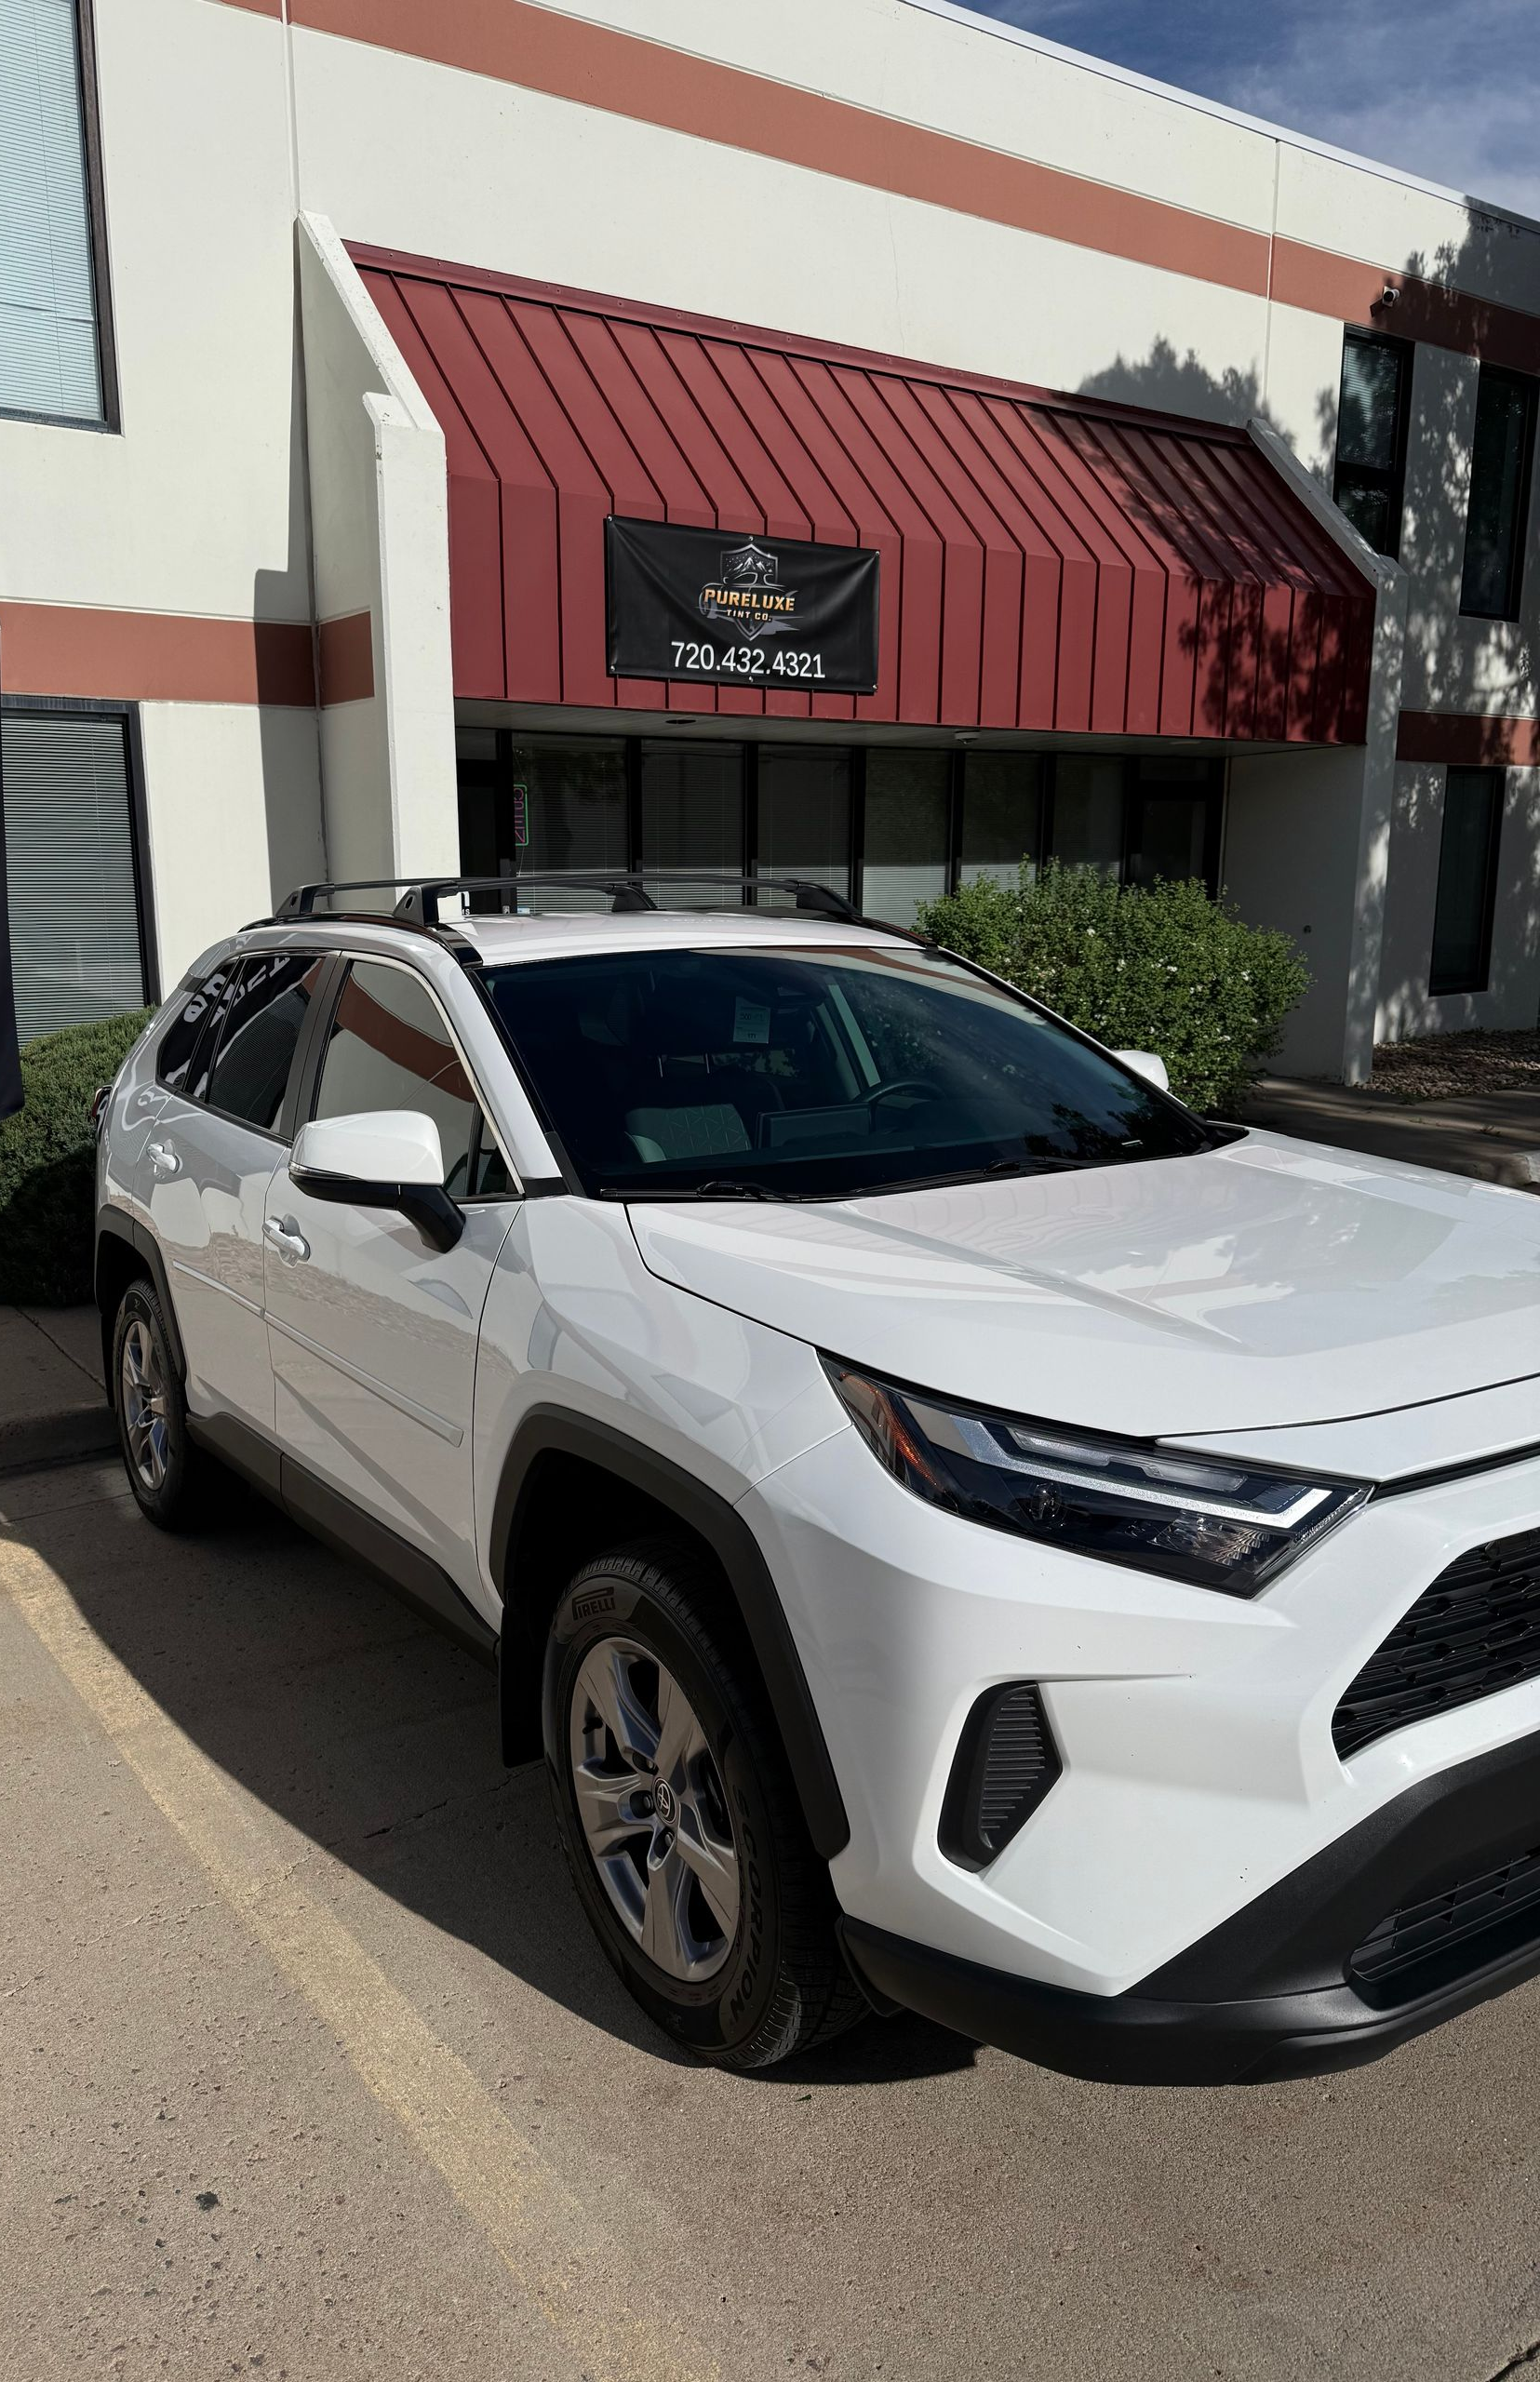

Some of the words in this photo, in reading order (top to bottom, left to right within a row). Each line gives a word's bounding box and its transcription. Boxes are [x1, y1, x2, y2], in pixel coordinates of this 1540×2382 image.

[703, 588, 796, 611] PURELUXE
[726, 609, 751, 619] TINT
[754, 611, 772, 622] CO.
[671, 640, 826, 678] 720.432.4321
[571, 1586, 616, 1621] PIRELLI
[731, 1784, 764, 2023] SCORPION
